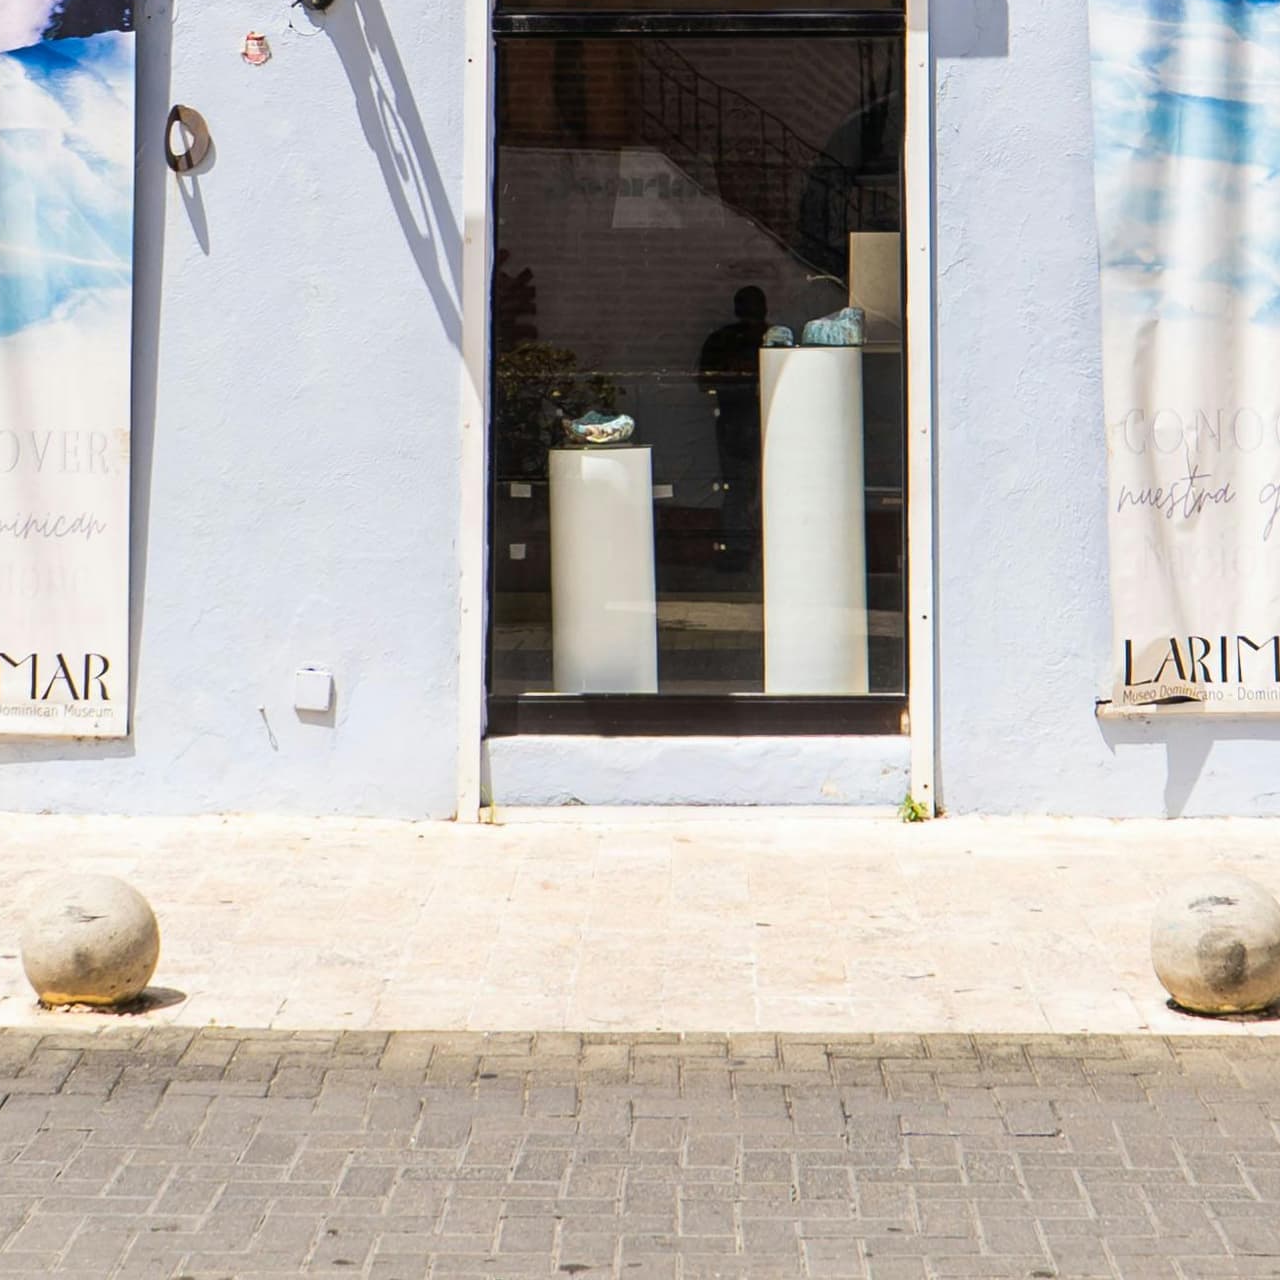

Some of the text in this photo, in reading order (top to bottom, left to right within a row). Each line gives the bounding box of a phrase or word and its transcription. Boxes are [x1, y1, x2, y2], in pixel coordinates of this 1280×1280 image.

[1116, 464, 1236, 519] nuestra
[1122, 688, 1157, 704] Museo
[1159, 684, 1225, 701] Dominicano
[63, 703, 114, 719] Museum
